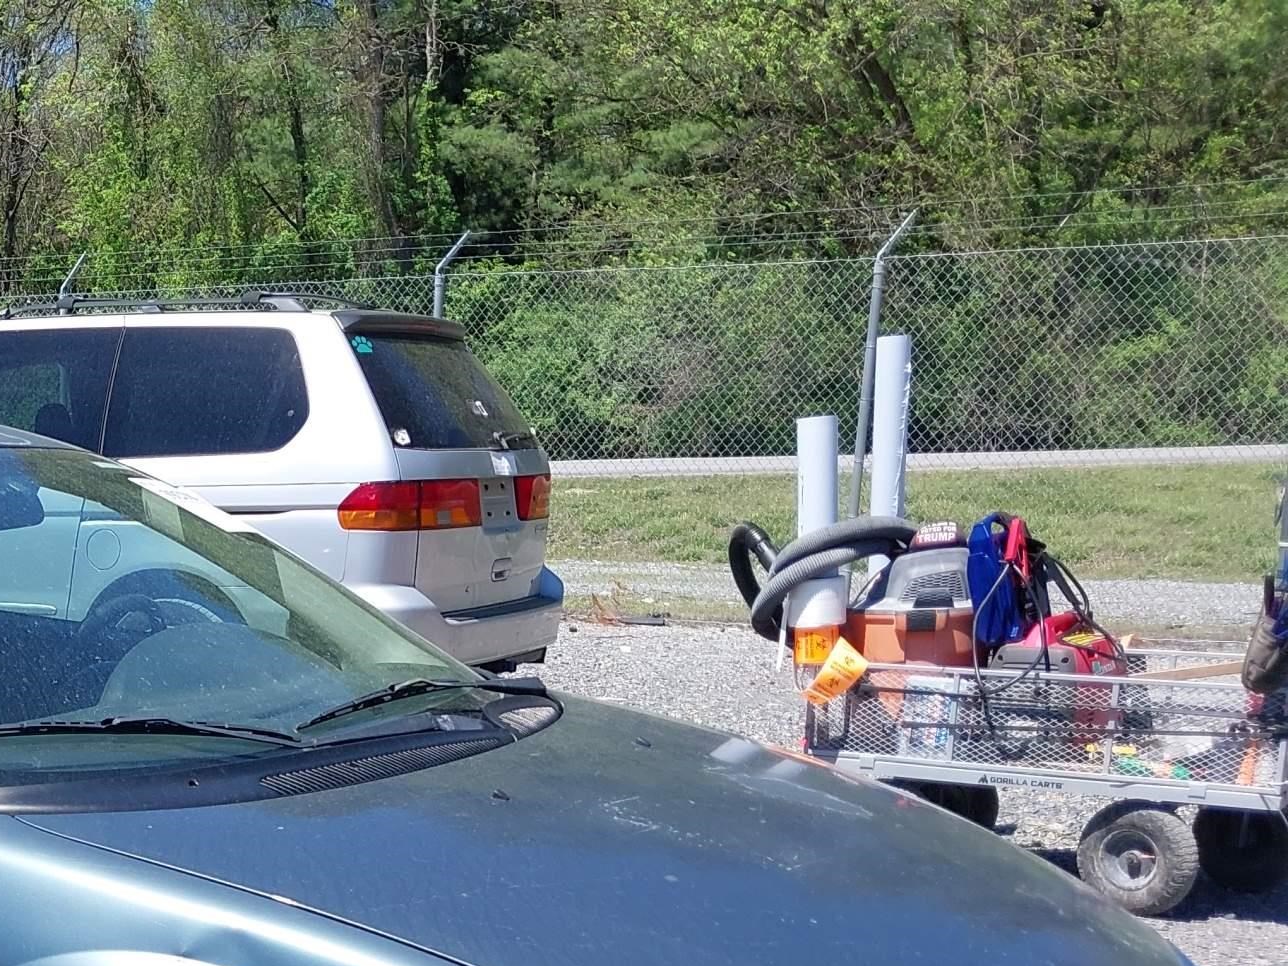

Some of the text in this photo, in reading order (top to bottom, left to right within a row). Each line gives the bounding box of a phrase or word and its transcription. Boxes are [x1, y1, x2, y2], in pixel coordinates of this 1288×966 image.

[917, 532, 956, 543] TRUMP
[990, 776, 1064, 790] GORILLA CARTS
